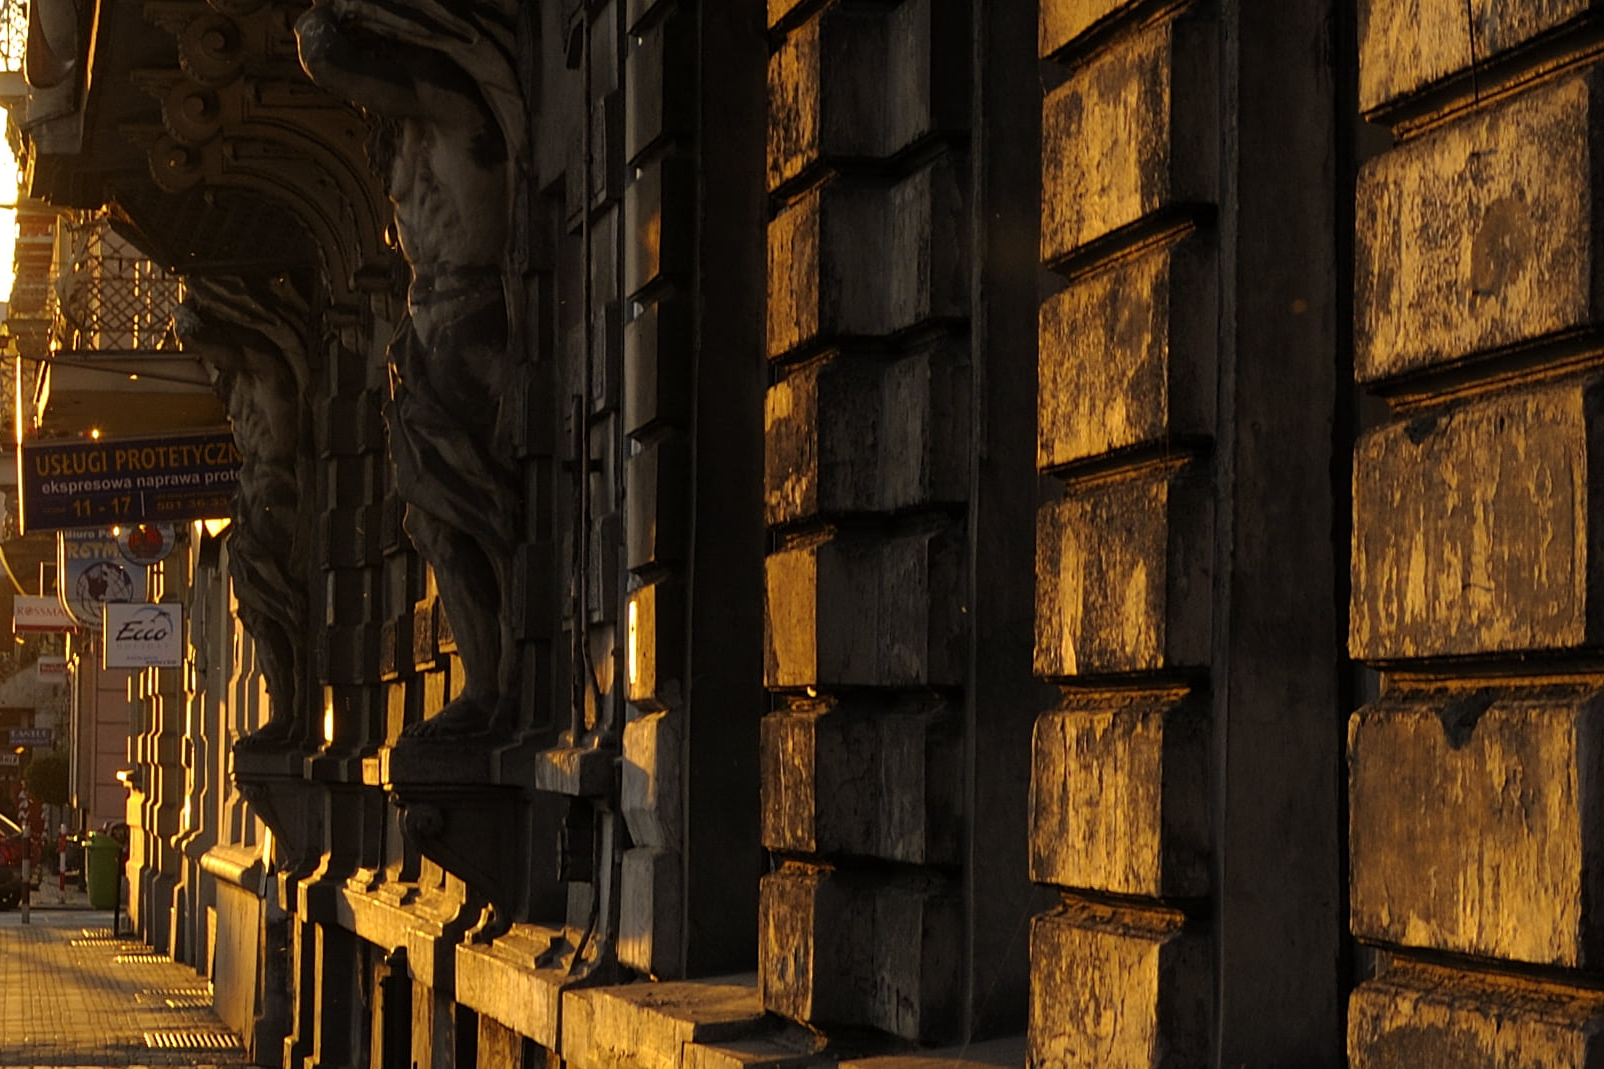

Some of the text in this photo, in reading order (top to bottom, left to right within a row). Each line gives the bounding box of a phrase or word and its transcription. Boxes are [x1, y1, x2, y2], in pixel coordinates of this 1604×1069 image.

[35, 441, 244, 477] USŁUGI PROTETYCZN
[41, 467, 241, 496] ekspresowa naprawa prote
[73, 498, 92, 517] 11
[111, 496, 132, 516] 17
[16, 606, 68, 617] ROSSMA
[115, 620, 168, 642] Ecco
